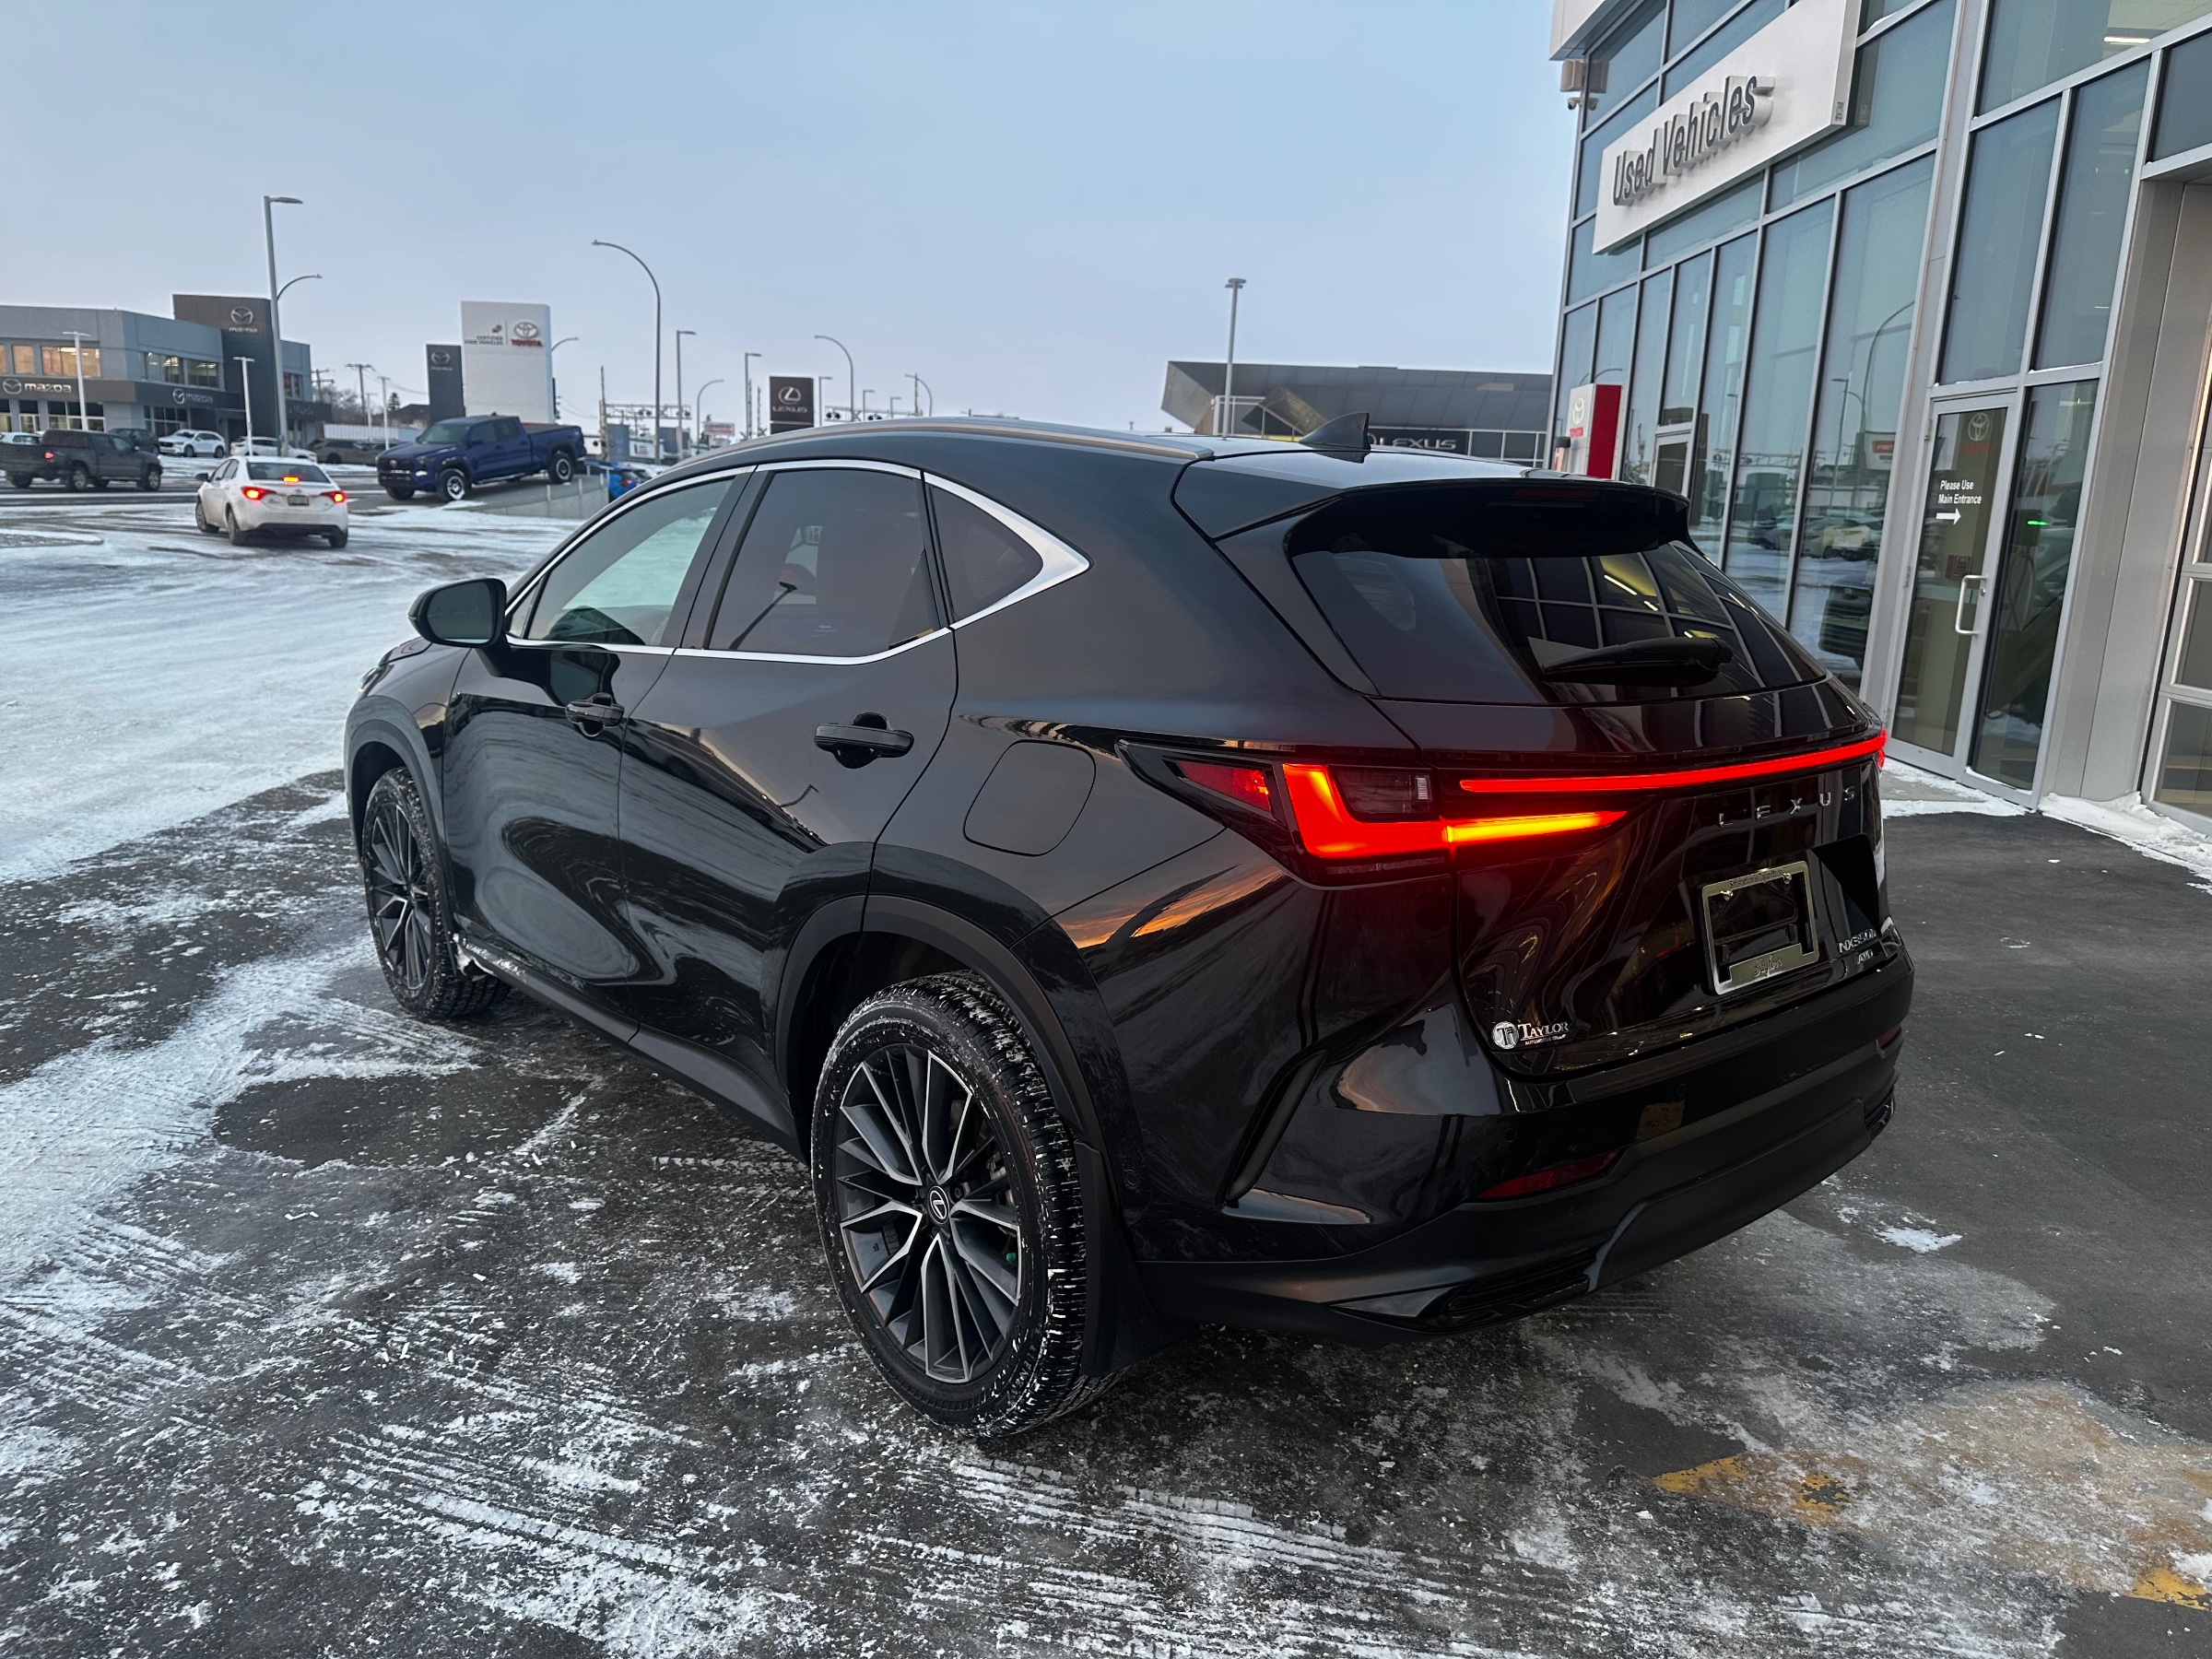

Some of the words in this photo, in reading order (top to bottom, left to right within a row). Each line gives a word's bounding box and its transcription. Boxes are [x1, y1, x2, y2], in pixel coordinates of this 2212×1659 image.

[1613, 128, 1660, 206] Used
[1663, 76, 1764, 175] Vehicles
[510, 337, 544, 347] TOYOTA
[771, 406, 808, 414] LEXUS
[1939, 480, 1960, 490] Please
[1961, 479, 1974, 490] Use
[1937, 494, 1953, 504] Main
[1953, 493, 1983, 504] Entrance
[1719, 786, 1855, 828] LEXUS
